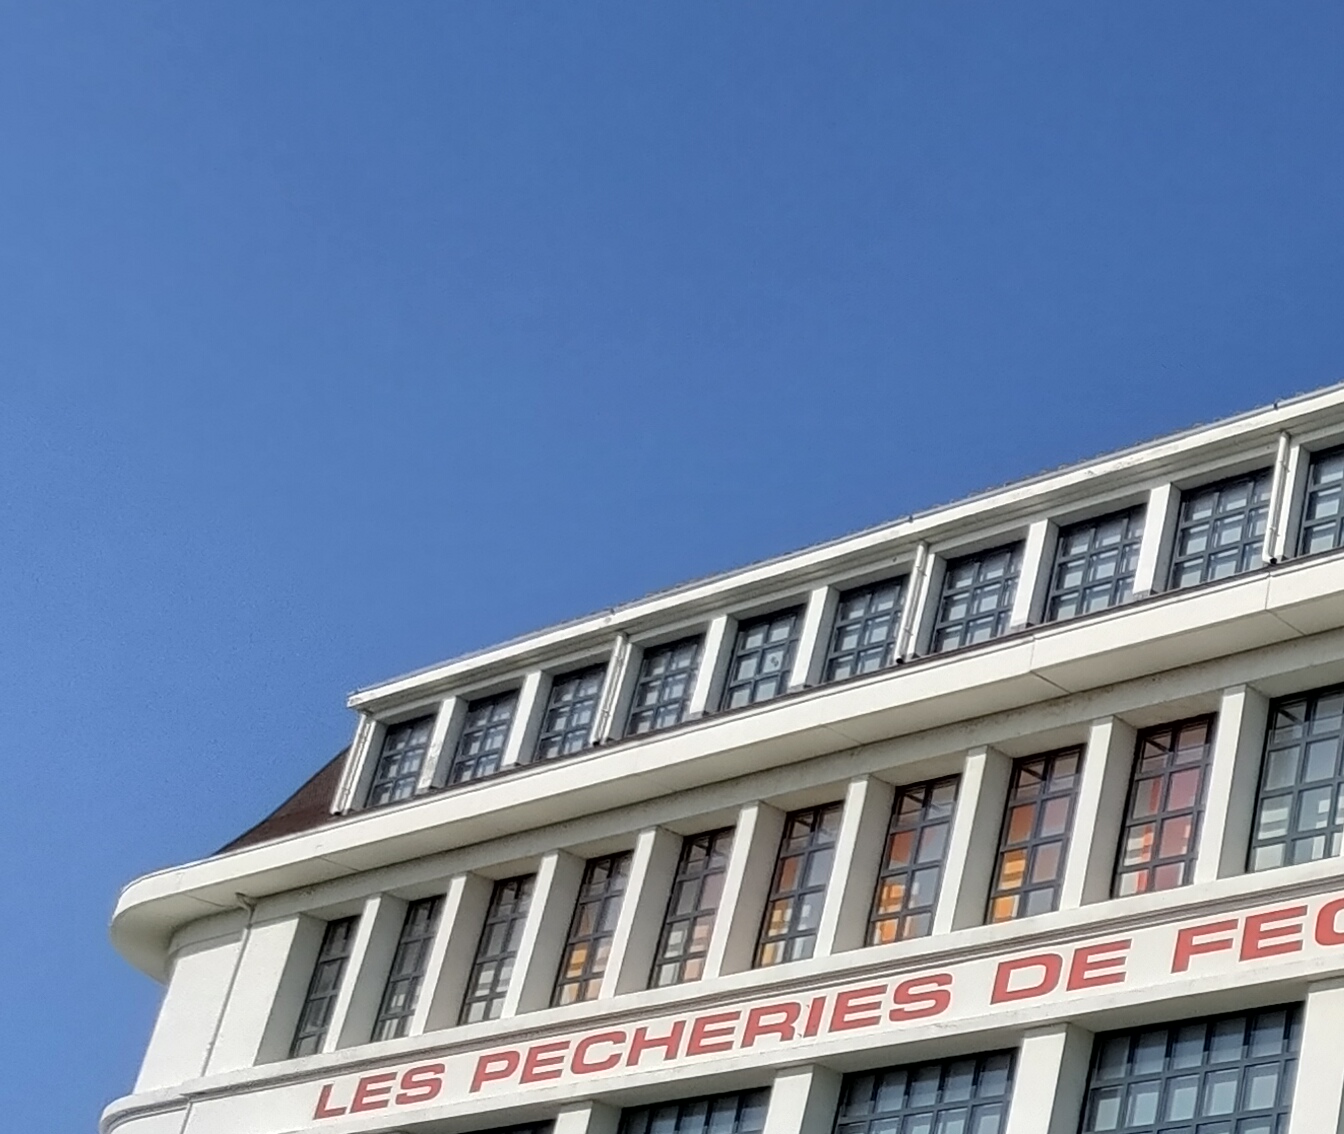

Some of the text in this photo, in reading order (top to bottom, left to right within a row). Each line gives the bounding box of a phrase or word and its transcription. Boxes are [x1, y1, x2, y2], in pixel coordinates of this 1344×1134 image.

[313, 1063, 446, 1120] LES
[470, 973, 953, 1093] PECHERIES
[990, 938, 1132, 1005] DE
